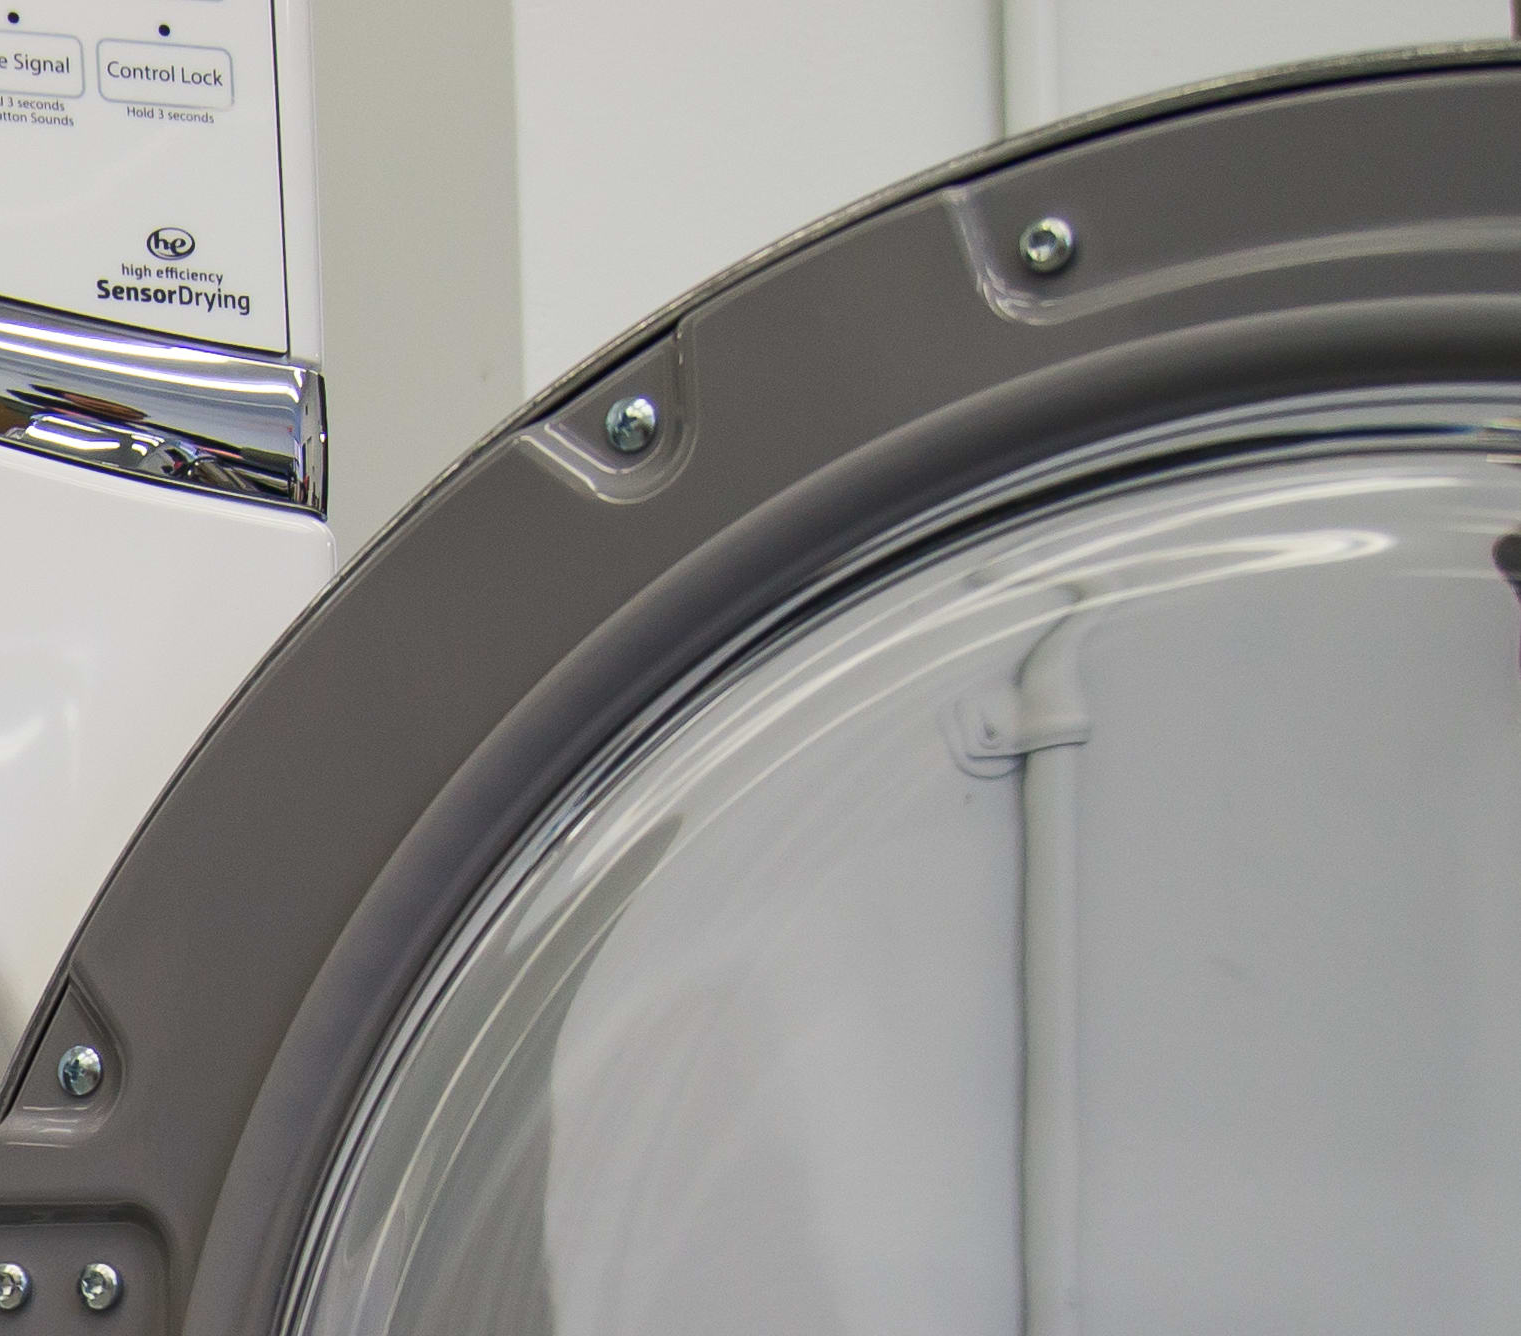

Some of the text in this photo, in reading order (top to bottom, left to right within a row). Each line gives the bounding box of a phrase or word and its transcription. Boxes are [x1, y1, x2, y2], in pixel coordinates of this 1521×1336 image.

[13, 52, 70, 76] Signal
[107, 60, 223, 87] Control Lock
[7, 97, 15, 108] 3
[17, 98, 65, 112] seconds
[126, 106, 215, 125] Hold 3 seconds
[31, 112, 74, 127] Sounds
[151, 229, 190, 258] he
[121, 263, 223, 286] high efficiency
[96, 279, 251, 316] SensorDrying
